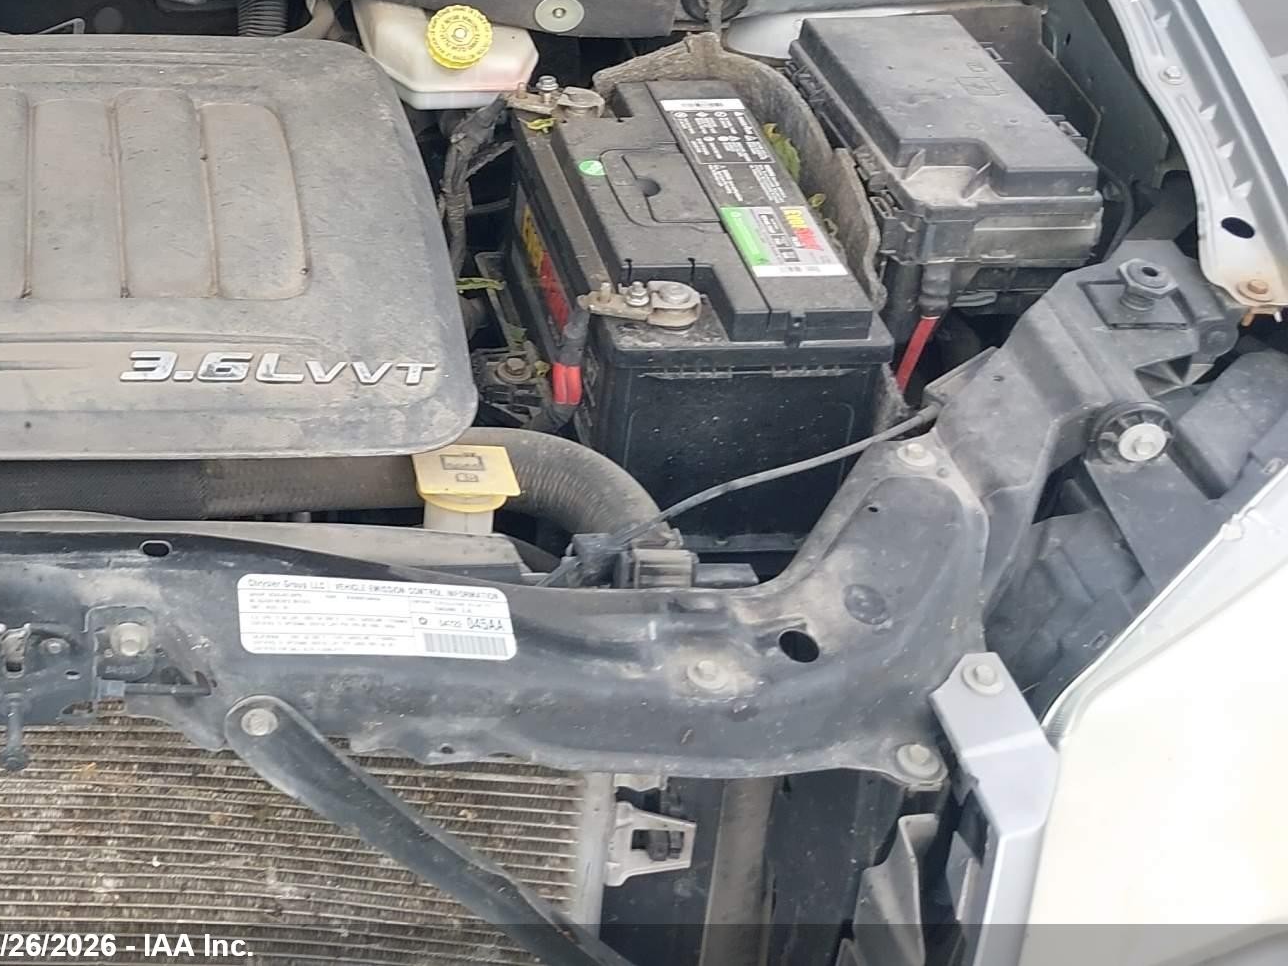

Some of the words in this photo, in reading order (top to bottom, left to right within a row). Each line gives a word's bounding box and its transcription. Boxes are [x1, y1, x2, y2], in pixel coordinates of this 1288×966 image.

[334, 582, 367, 592] VEHICLE
[407, 586, 443, 596] CONTROL
[446, 589, 499, 600] INFORMATION
